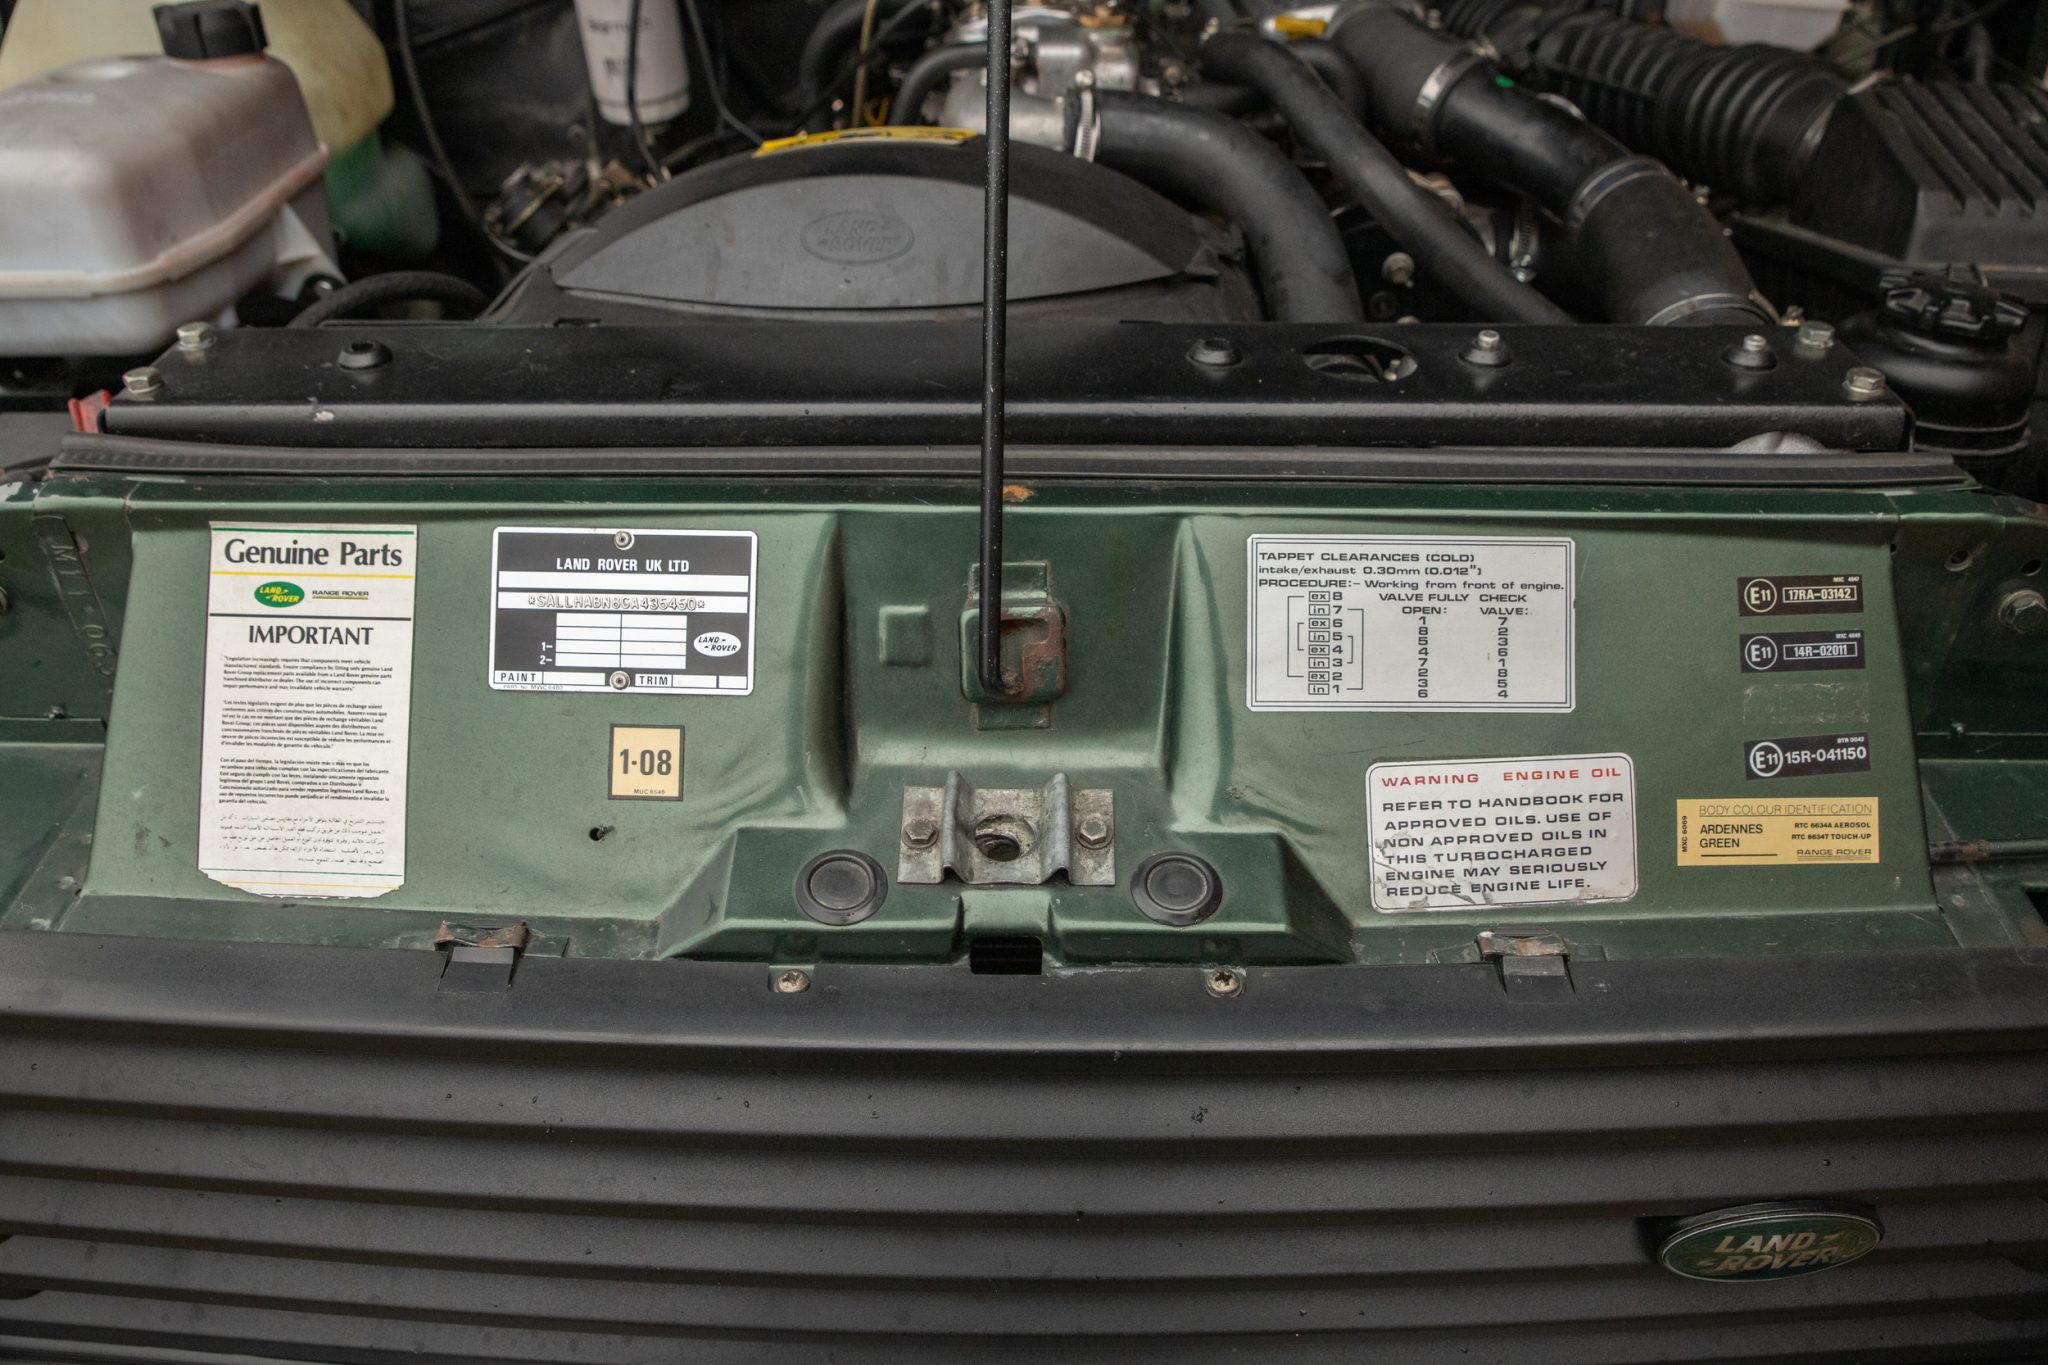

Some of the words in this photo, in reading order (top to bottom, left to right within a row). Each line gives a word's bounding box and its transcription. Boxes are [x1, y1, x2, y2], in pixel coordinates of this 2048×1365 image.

[224, 539, 328, 565] Genuine
[340, 542, 402, 566] Parts
[1259, 553, 1314, 561] TAPPET
[1321, 553, 1420, 562] CLEARANCES
[1426, 553, 1474, 562] (COLD)
[557, 558, 590, 570] LAND
[598, 558, 637, 571] ROVER
[646, 559, 662, 572] UK
[668, 560, 689, 572] LTD
[1259, 566, 1356, 575] intake/exhaust
[1363, 566, 1420, 575] 0.30mm
[1425, 565, 1482, 576] (0.012")
[259, 586, 282, 594] LAND
[1259, 580, 1360, 588] PROCEDURE:-
[1365, 580, 1418, 591] Working
[1426, 580, 1456, 589] from
[1463, 580, 1495, 589] front
[1502, 581, 1514, 590] of
[1520, 582, 1564, 591] engine.
[1332, 592, 1342, 601] 8
[1379, 593, 1423, 602] VALVE
[1429, 593, 1469, 602] FULLY
[1479, 594, 1527, 602] CHECK
[1750, 587, 1770, 604] E11
[1788, 589, 1851, 600] 17RA-03142
[1314, 606, 1326, 614] in
[1332, 605, 1342, 614] 7
[1402, 606, 1447, 615] OPEN:
[1480, 607, 1528, 616] VALVE:
[1332, 618, 1342, 628] 6
[1419, 617, 1426, 625] 1
[1498, 617, 1508, 626] 7
[249, 625, 374, 644] IMPORTANT
[1419, 627, 1428, 636] 8
[1498, 628, 1508, 636] 2
[698, 636, 719, 644] LAND
[1314, 633, 1326, 641] in
[1332, 632, 1342, 641] 5
[1419, 637, 1428, 646] 5
[1498, 638, 1508, 646] 3
[1332, 645, 1342, 654] 4
[1419, 648, 1428, 656] 4
[1498, 648, 1508, 656] 6
[1751, 645, 1771, 661] E11
[1794, 645, 1847, 657] 14R-02011
[1314, 659, 1326, 667] in
[1332, 658, 1342, 667] 3
[1419, 658, 1428, 666] 7
[1499, 658, 1506, 667] 1
[500, 673, 536, 682] PAINT
[1332, 672, 1342, 681] 2
[1419, 669, 1428, 677] 2
[1498, 669, 1508, 678] 8
[640, 676, 668, 685] TRIM
[1419, 679, 1428, 688] 3
[1498, 680, 1508, 688] 5
[1333, 685, 1340, 694] 1
[1419, 690, 1428, 698] 6
[1498, 690, 1508, 698] 4
[1756, 751, 1778, 768] E11
[1785, 747, 1866, 764] 15R-041150
[1382, 774, 1479, 787] WARNING
[1504, 770, 1580, 781] ENGINE
[1591, 768, 1621, 778] OIL
[1383, 801, 1442, 812] REFER
[1448, 800, 1471, 809] TO
[1479, 795, 1583, 808] HANDBOOK
[1589, 793, 1624, 803] FOR
[1699, 805, 1731, 815] BODY
[1733, 805, 1781, 814] COLOUR
[1785, 804, 1872, 814] IDENTIFICATION
[1384, 817, 1486, 830] APPROVED
[1495, 814, 1541, 825] OILS.
[1546, 813, 1581, 823] USE
[1588, 812, 1612, 821] OF
[1700, 825, 1763, 834] ARDENNES
[1384, 837, 1424, 848] NON
[1431, 832, 1533, 846] APPROVED
[1542, 830, 1582, 840] OILS
[1589, 829, 1607, 838] IN
[1700, 839, 1740, 848] GREEN
[1385, 854, 1426, 865] THIS
[1434, 846, 1591, 862] TURBOCHARGED
[1386, 869, 1454, 881] ENGINE
[1463, 867, 1500, 877] MAY
[1510, 861, 1607, 875] SERIOUSLY
[1387, 884, 1461, 896] REDUCE
[1471, 881, 1540, 892] ENGINE
[1548, 879, 1590, 889] LIFE.
[1714, 1231, 1816, 1253] LAND
[1714, 1246, 1841, 1271] ROVER
